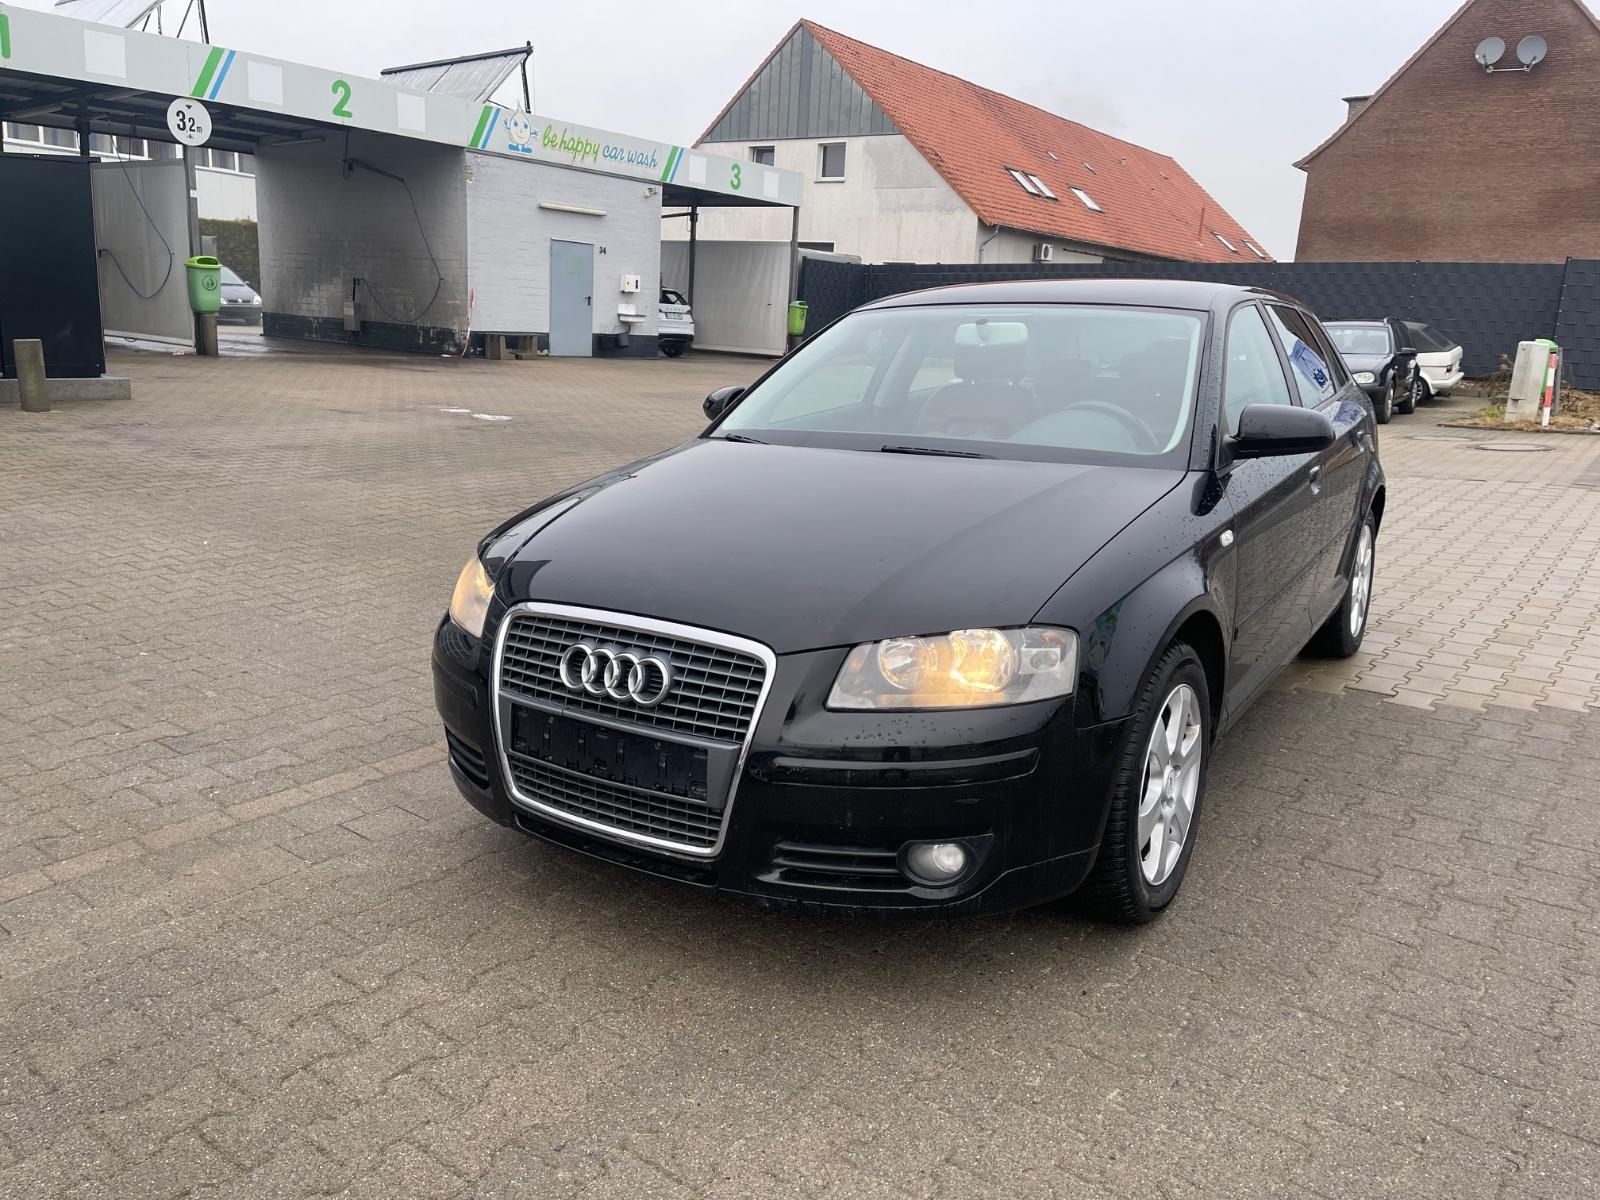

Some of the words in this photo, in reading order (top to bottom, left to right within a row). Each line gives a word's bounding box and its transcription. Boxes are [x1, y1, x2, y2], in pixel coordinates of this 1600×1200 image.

[332, 79, 353, 118] 2
[542, 123, 559, 148] be
[559, 128, 600, 163] happy
[602, 144, 625, 161] car
[627, 147, 657, 168] wash
[730, 163, 741, 190] 3
